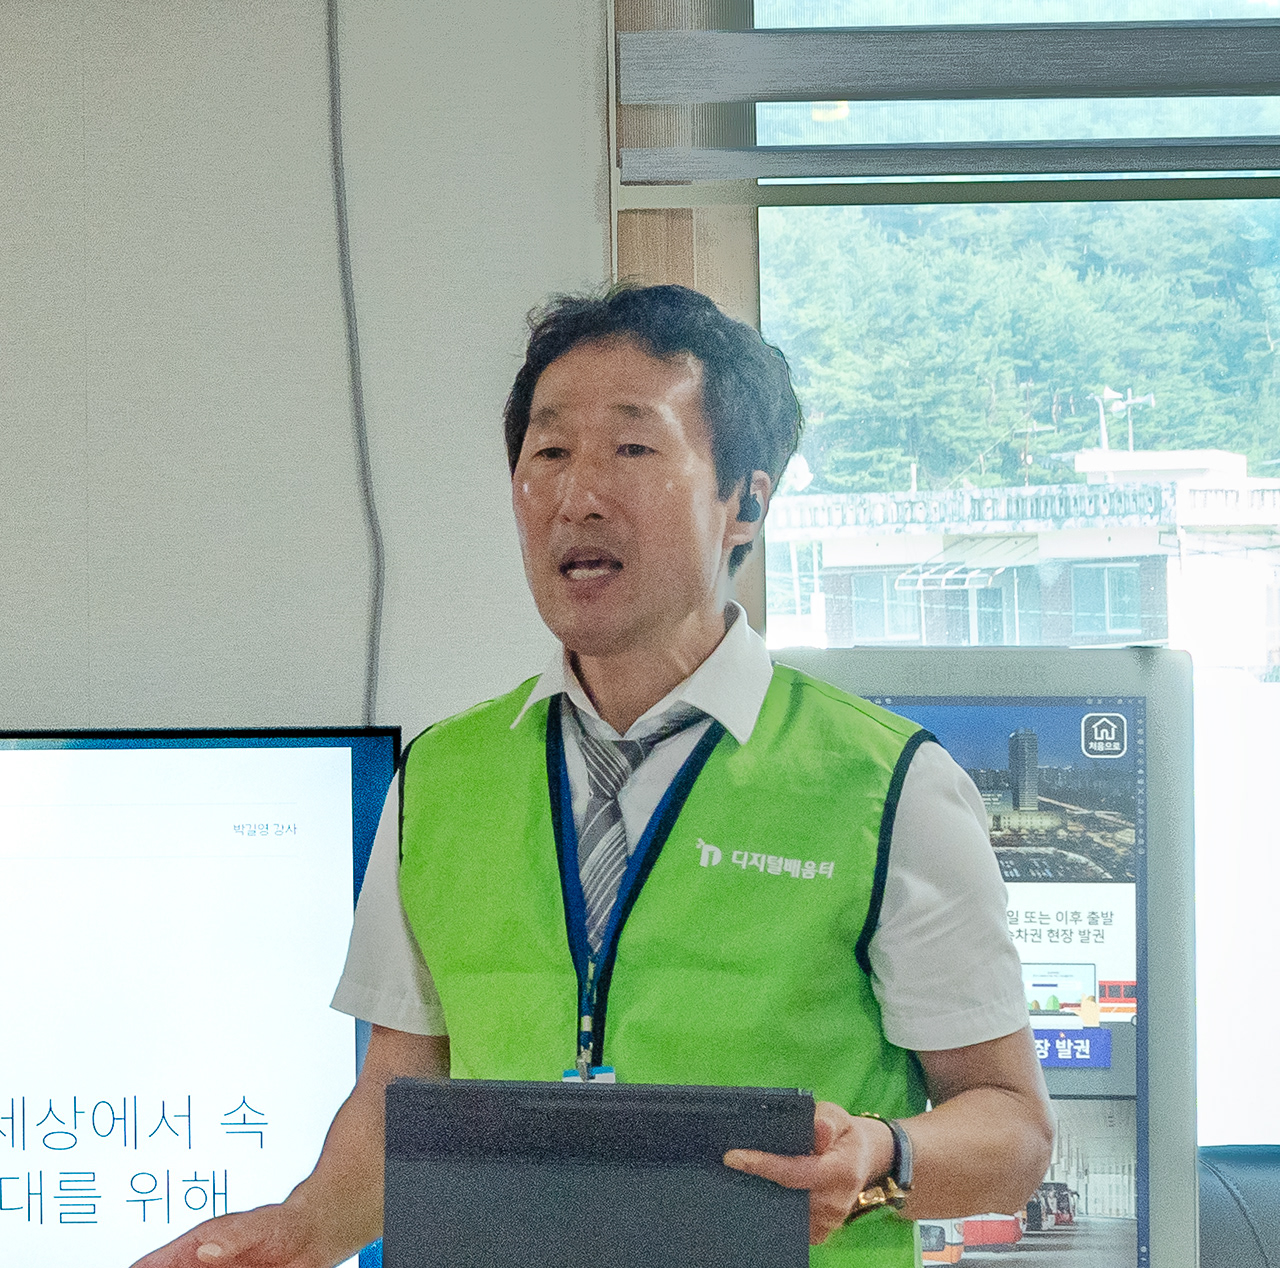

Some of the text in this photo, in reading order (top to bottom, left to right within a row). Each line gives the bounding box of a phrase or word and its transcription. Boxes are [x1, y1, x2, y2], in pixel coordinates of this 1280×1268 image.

[233, 822, 298, 837] 박길영 강사
[731, 849, 835, 880] 디지털배움터
[1024, 910, 1052, 925] 또는
[1056, 910, 1083, 925] 이후
[1087, 910, 1115, 926] 출발
[1046, 928, 1075, 943] 현장
[1078, 928, 1106, 944] 발권
[1055, 1038, 1091, 1060] 발권
[219, 1094, 271, 1152] 속
[126, 1166, 231, 1226] 위해
